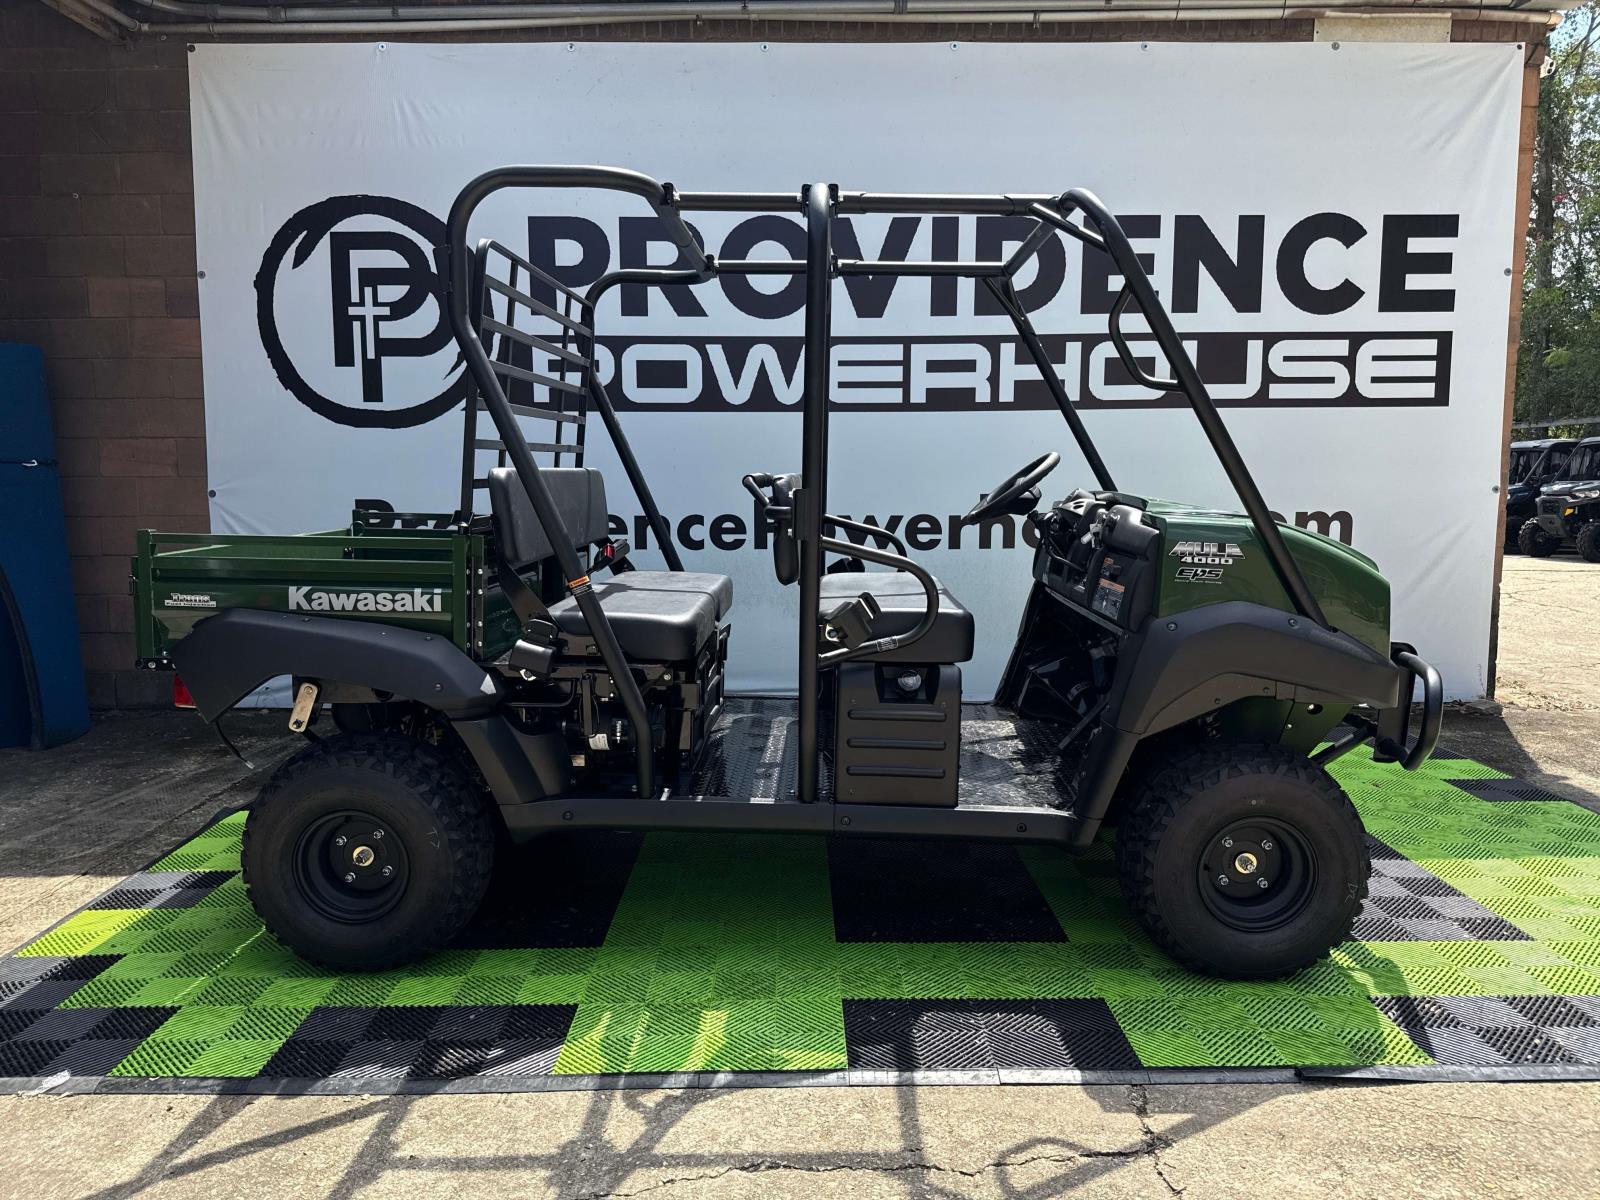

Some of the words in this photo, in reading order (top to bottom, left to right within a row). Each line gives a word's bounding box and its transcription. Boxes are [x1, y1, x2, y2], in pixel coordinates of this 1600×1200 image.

[528, 212, 1459, 319] PROVIDENCE
[532, 337, 1438, 404] POWERHOUSE
[1169, 542, 1246, 559] MULE
[1181, 556, 1233, 565] 4000
[288, 585, 442, 612] Kawasaki
